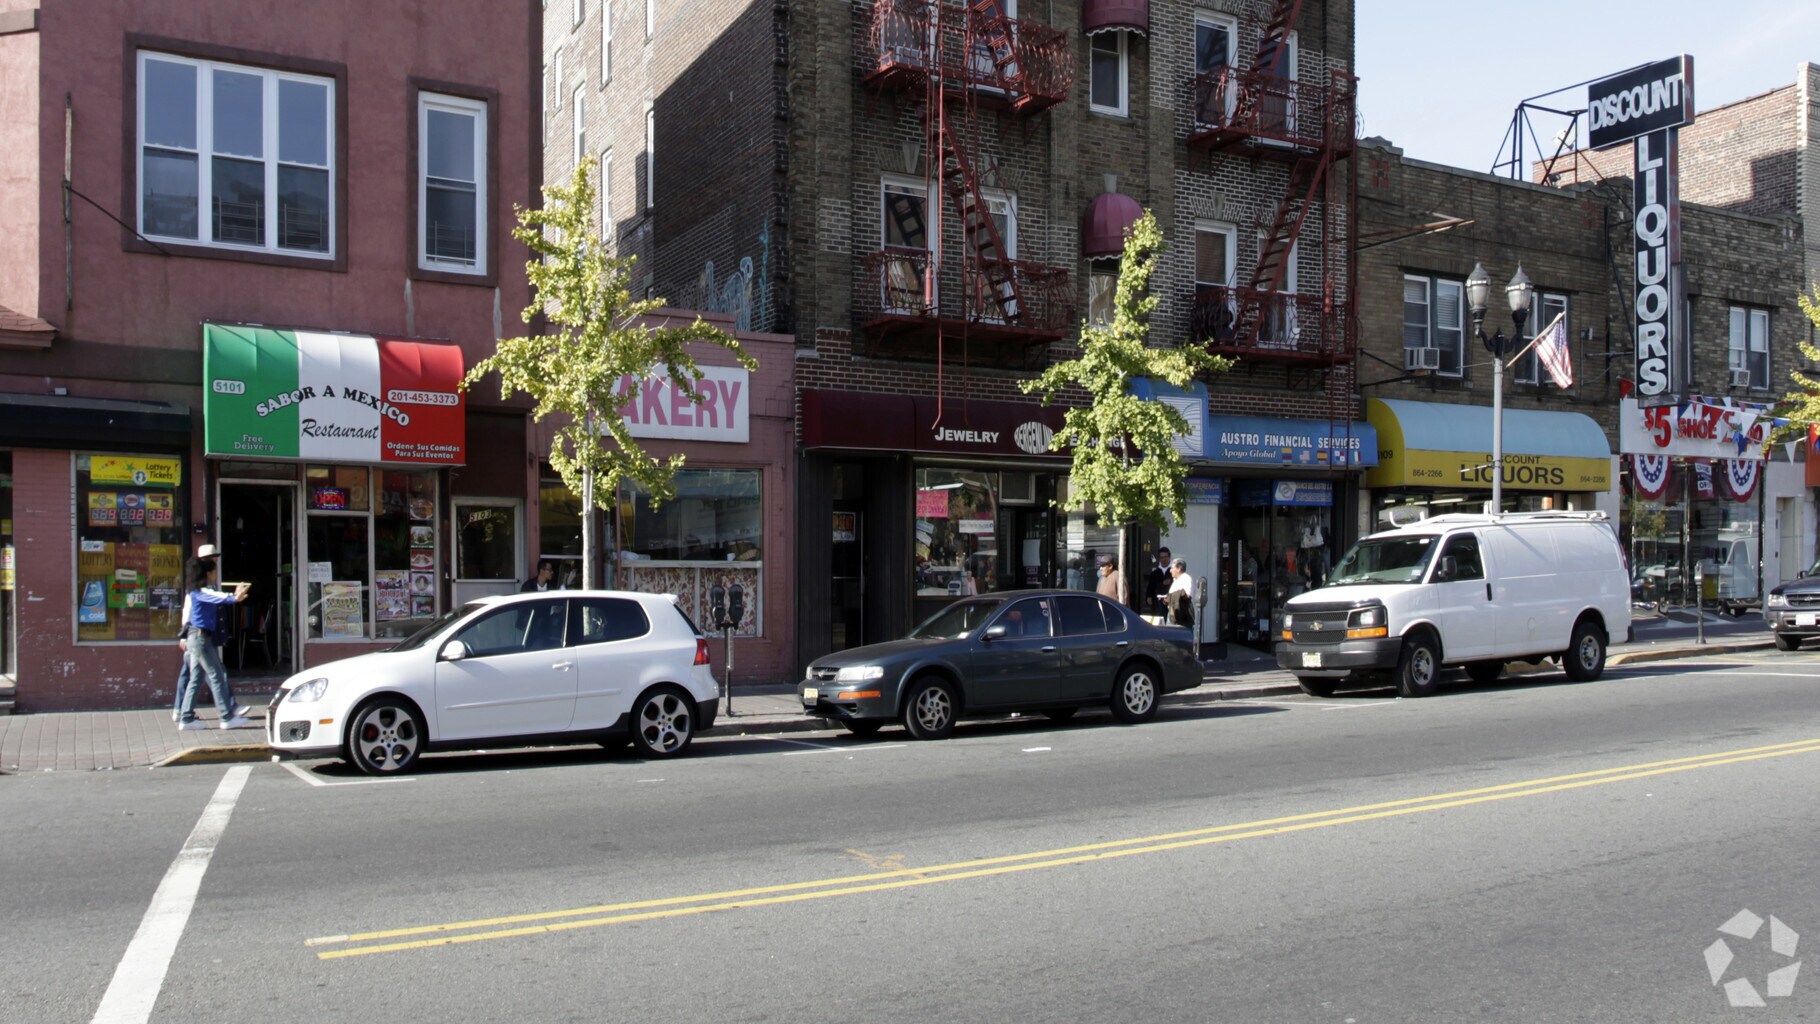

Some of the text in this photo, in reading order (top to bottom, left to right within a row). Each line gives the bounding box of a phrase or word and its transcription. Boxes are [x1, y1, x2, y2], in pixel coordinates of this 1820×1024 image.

[1590, 73, 1683, 131] DISCOUNT
[1637, 135, 1668, 395] LIQUORS
[215, 381, 242, 393] 5101
[390, 391, 456, 405] 201-453-3373
[590, 373, 742, 428] AKERY
[257, 385, 410, 426] SABOR A MEXICO
[301, 418, 379, 439] Restaurant
[935, 426, 999, 443] JEWELRY
[242, 434, 264, 443] Free
[1221, 432, 1360, 449] AUSTRO FINANCIAL SERVICES
[234, 442, 274, 452] Delivery
[387, 442, 460, 452] Ordene Sus Comidas
[1221, 448, 1276, 459] Apoyo Global
[412, 450, 424, 458] Sus
[426, 451, 454, 459] Eventos
[1486, 454, 1541, 465] DSCOUNT
[146, 463, 171, 472] Lottery
[150, 472, 173, 480] Tickets
[315, 492, 344, 506] OPEN
